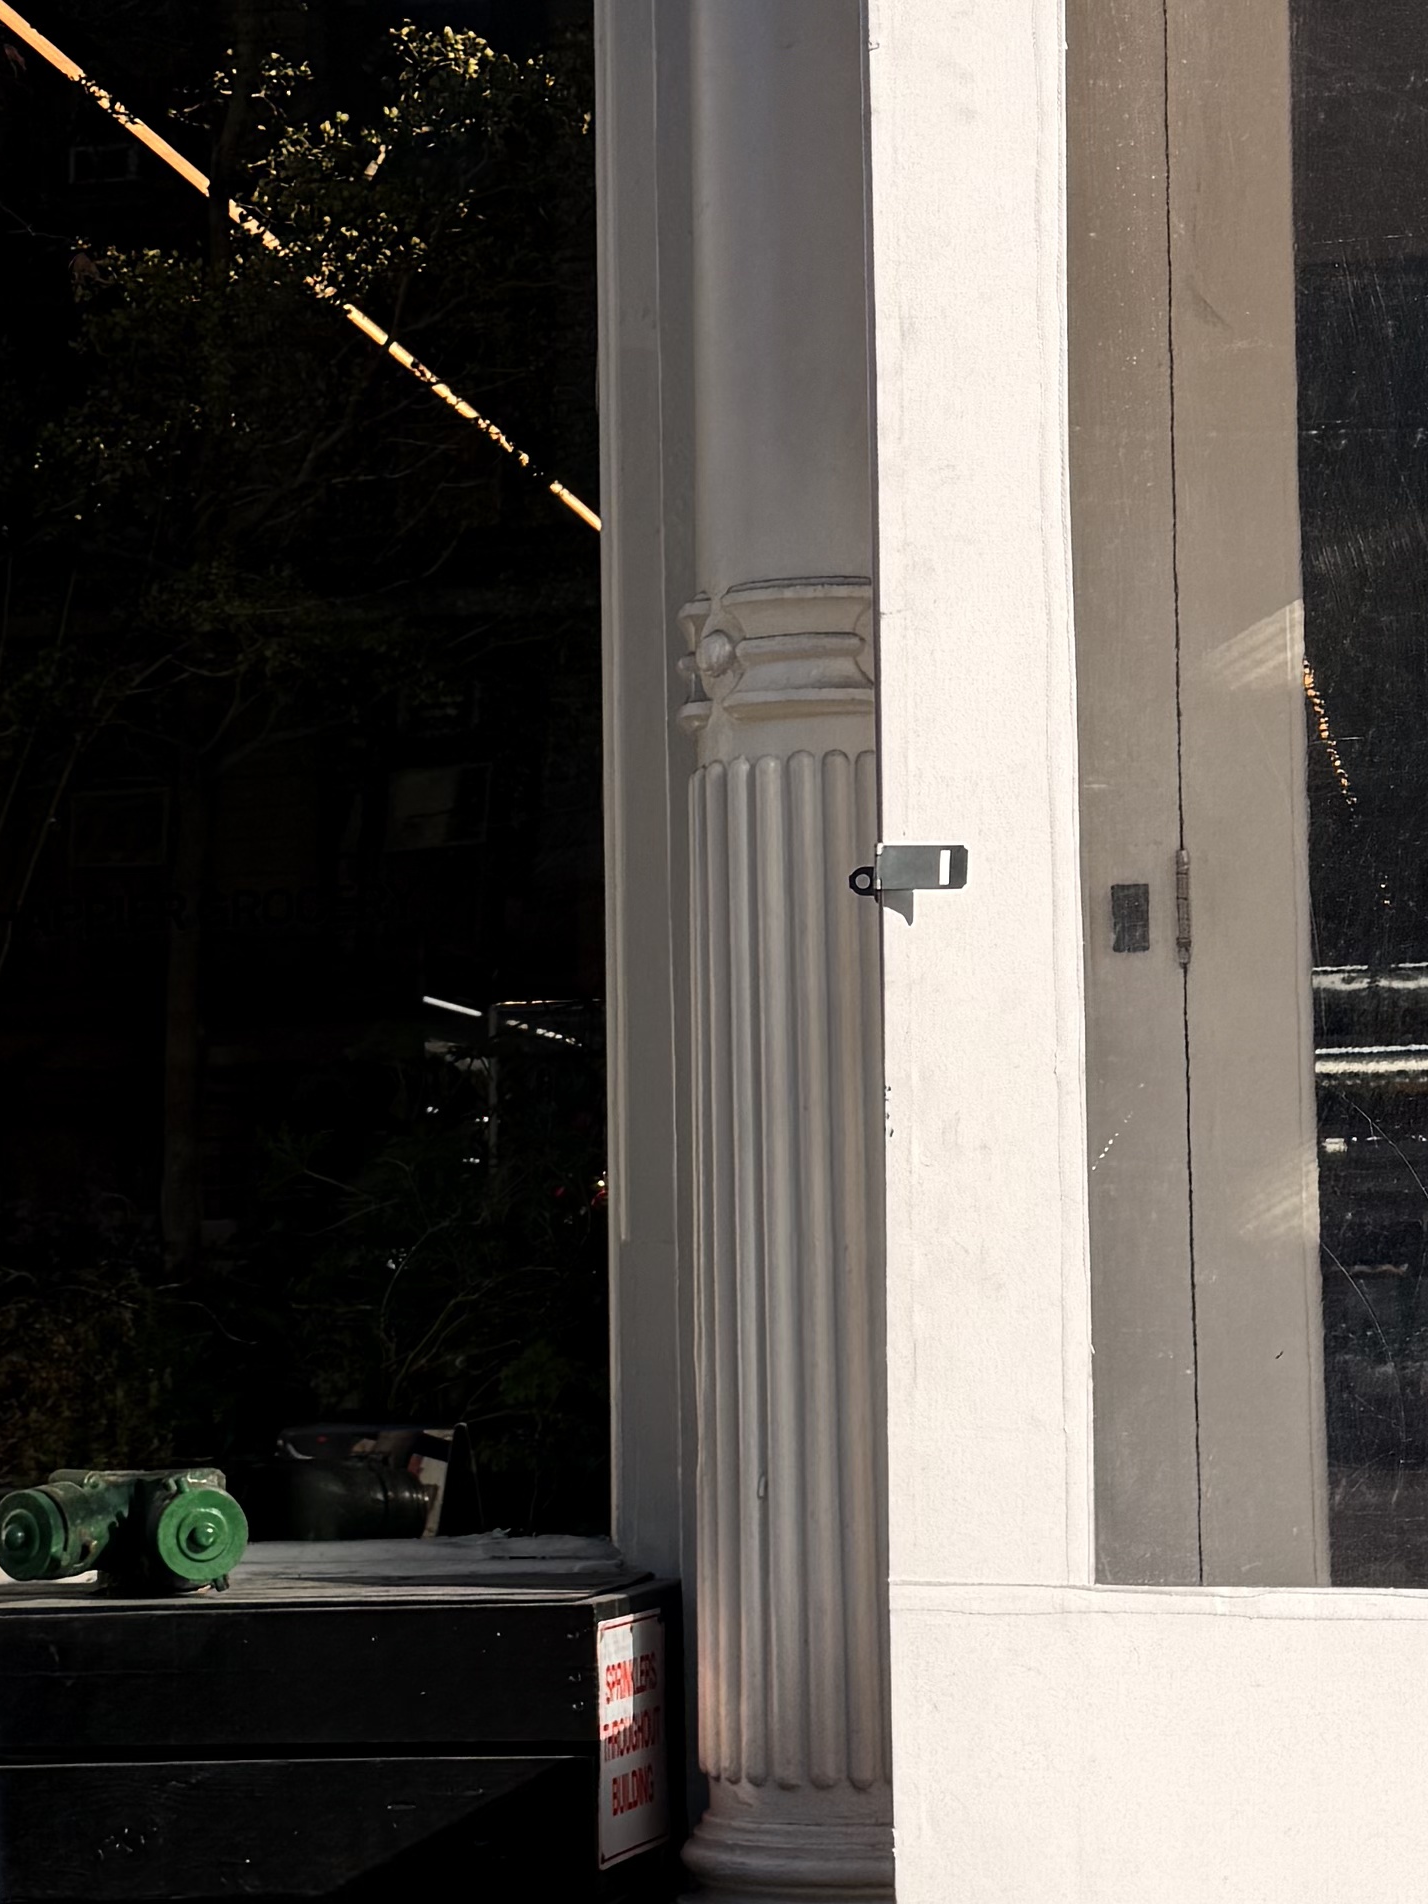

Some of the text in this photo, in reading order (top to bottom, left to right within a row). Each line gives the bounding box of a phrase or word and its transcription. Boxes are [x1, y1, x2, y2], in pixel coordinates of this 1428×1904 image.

[605, 1652, 658, 1705] SPRINKLERS
[603, 1706, 661, 1762] THROUGHOUT
[612, 1764, 654, 1817] BUILDING
